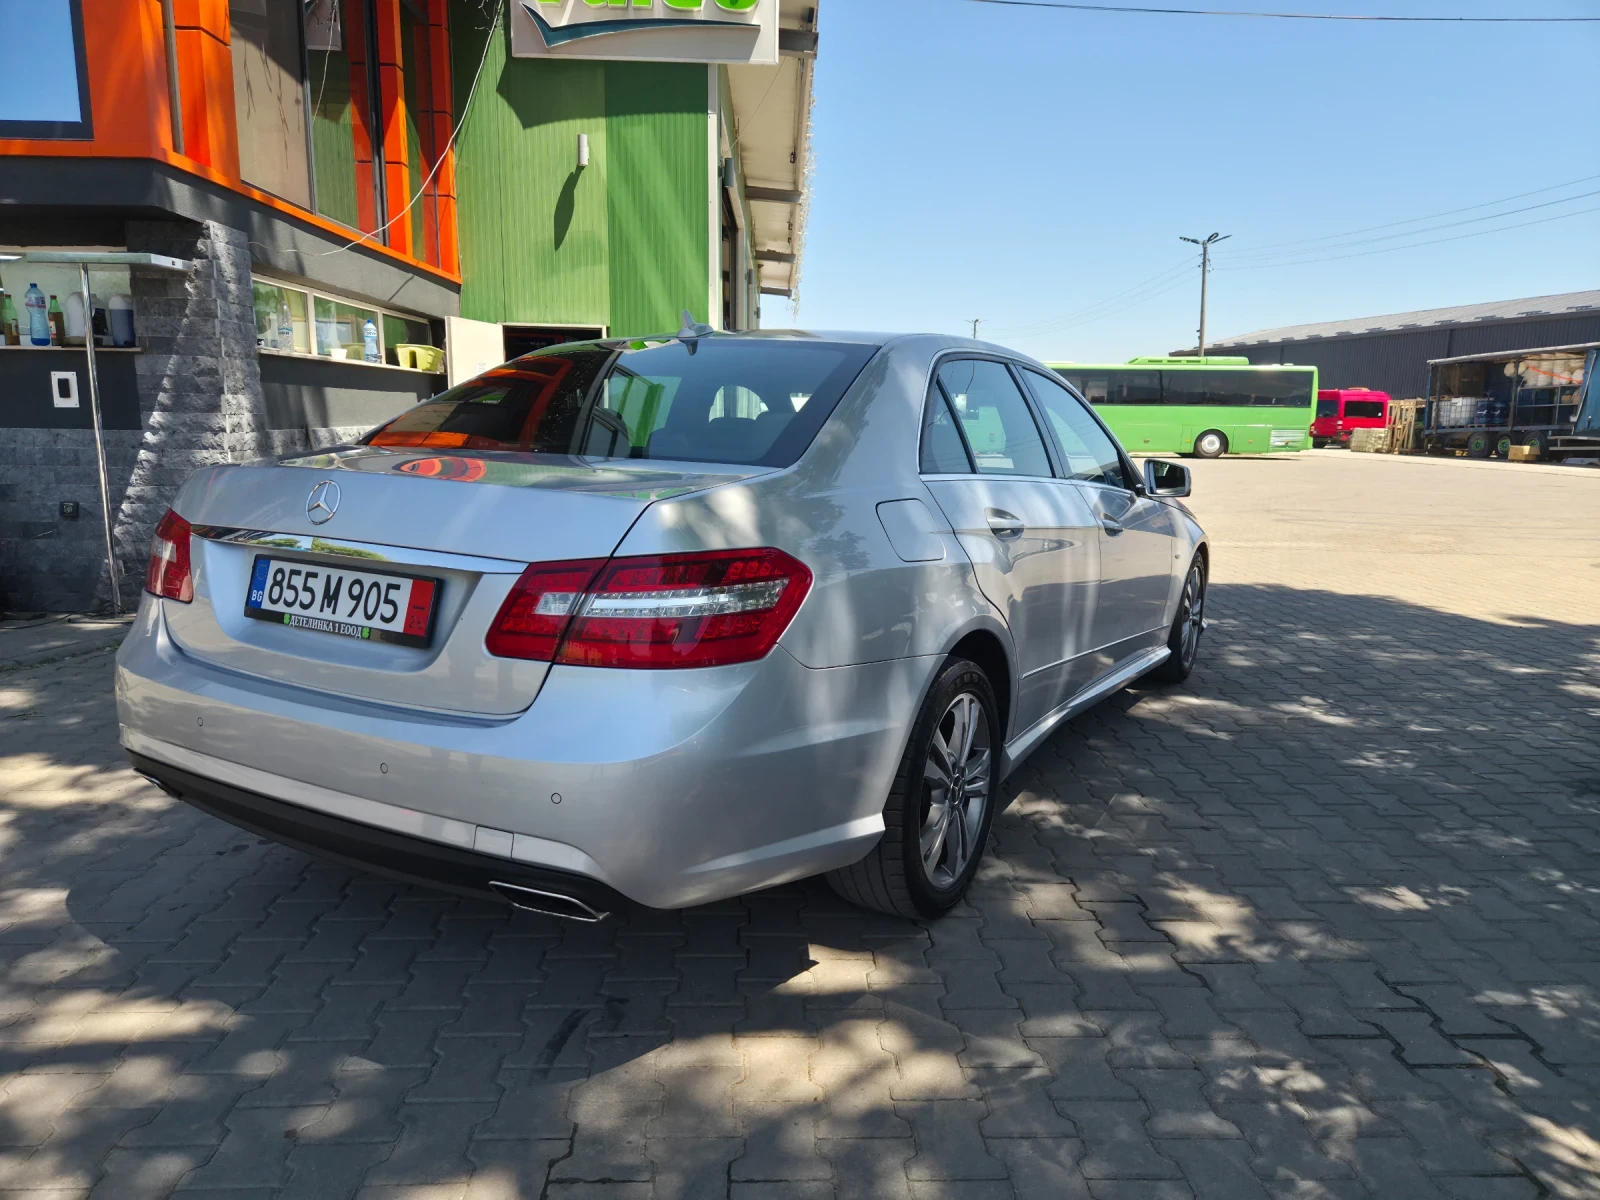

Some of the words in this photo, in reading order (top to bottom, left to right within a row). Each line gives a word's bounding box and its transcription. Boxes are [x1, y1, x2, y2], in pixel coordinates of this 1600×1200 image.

[251, 589, 263, 602] BG
[267, 567, 319, 611] 855
[319, 574, 344, 616] M
[347, 578, 401, 624] 905
[288, 615, 334, 634] ДЕТЕЛИНКА
[334, 623, 339, 633] 1
[340, 624, 362, 639] ЕООД
